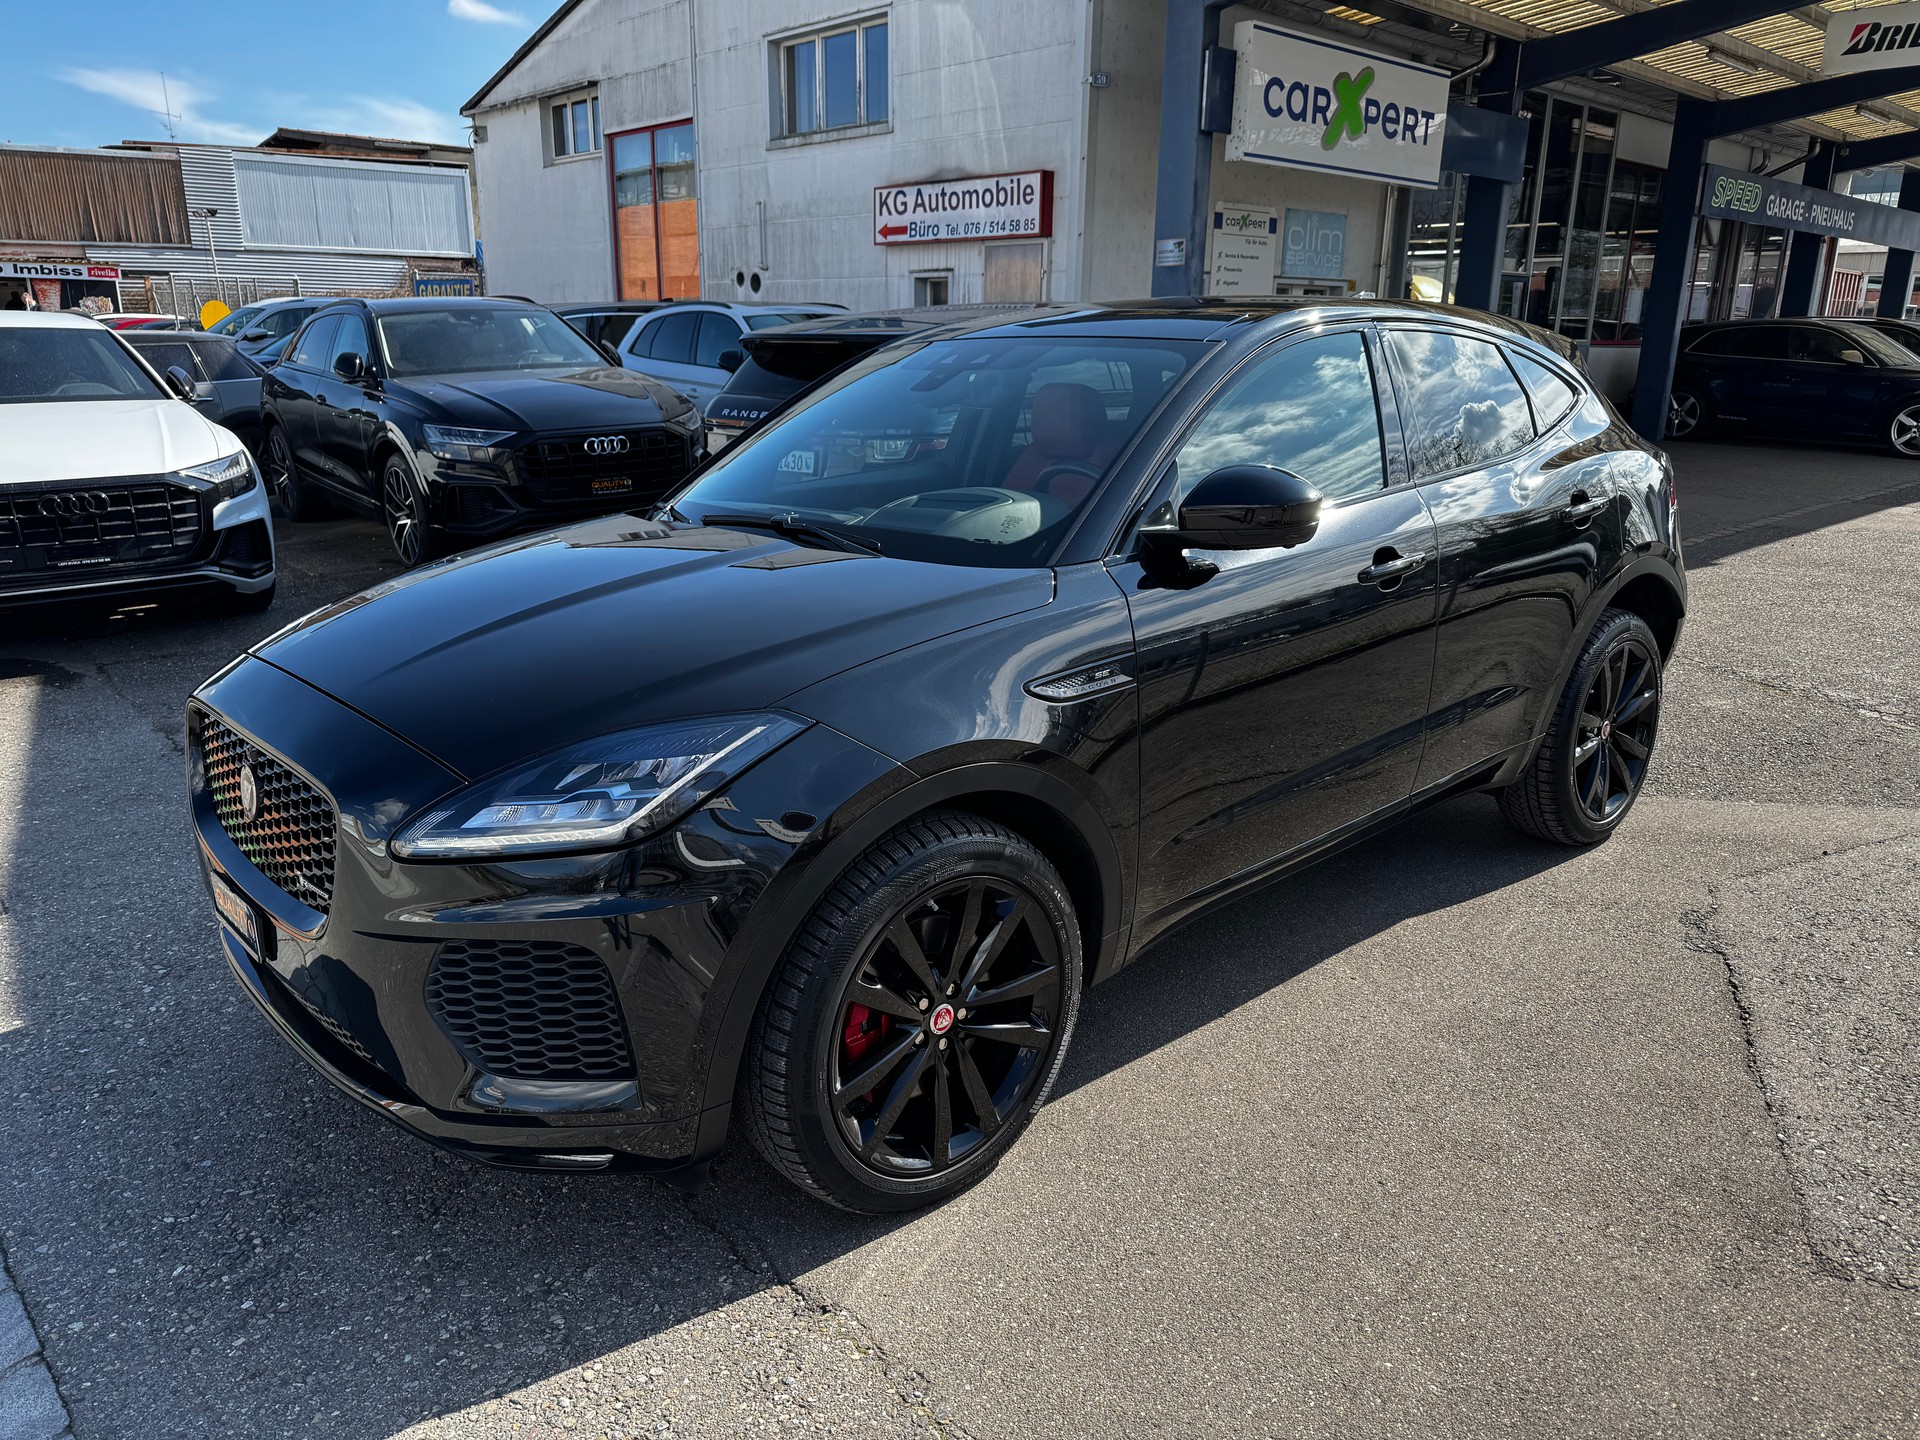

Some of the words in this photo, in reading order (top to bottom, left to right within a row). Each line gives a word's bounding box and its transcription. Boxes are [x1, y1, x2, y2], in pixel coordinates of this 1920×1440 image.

[879, 190, 907, 216] KG
[912, 178, 1034, 214] Automobile
[1711, 176, 1762, 213] SPEED
[1766, 194, 1804, 221] GARAGE
[1810, 204, 1855, 231] PNEUHAUS
[909, 221, 939, 238] Büro
[945, 224, 960, 236] Tel.
[964, 222, 980, 235] 076
[989, 220, 1005, 233] 514
[1009, 219, 1020, 232] 58
[1024, 218, 1035, 231] 85
[1288, 216, 1343, 253] clim
[1286, 250, 1341, 267] service
[13, 263, 83, 276] Imbiss
[91, 268, 116, 276] rivella
[419, 284, 470, 296] GARANTIE
[722, 408, 768, 418] RANGE
[1094, 669, 1110, 679] SE
[1074, 678, 1116, 693] JAGUAR
